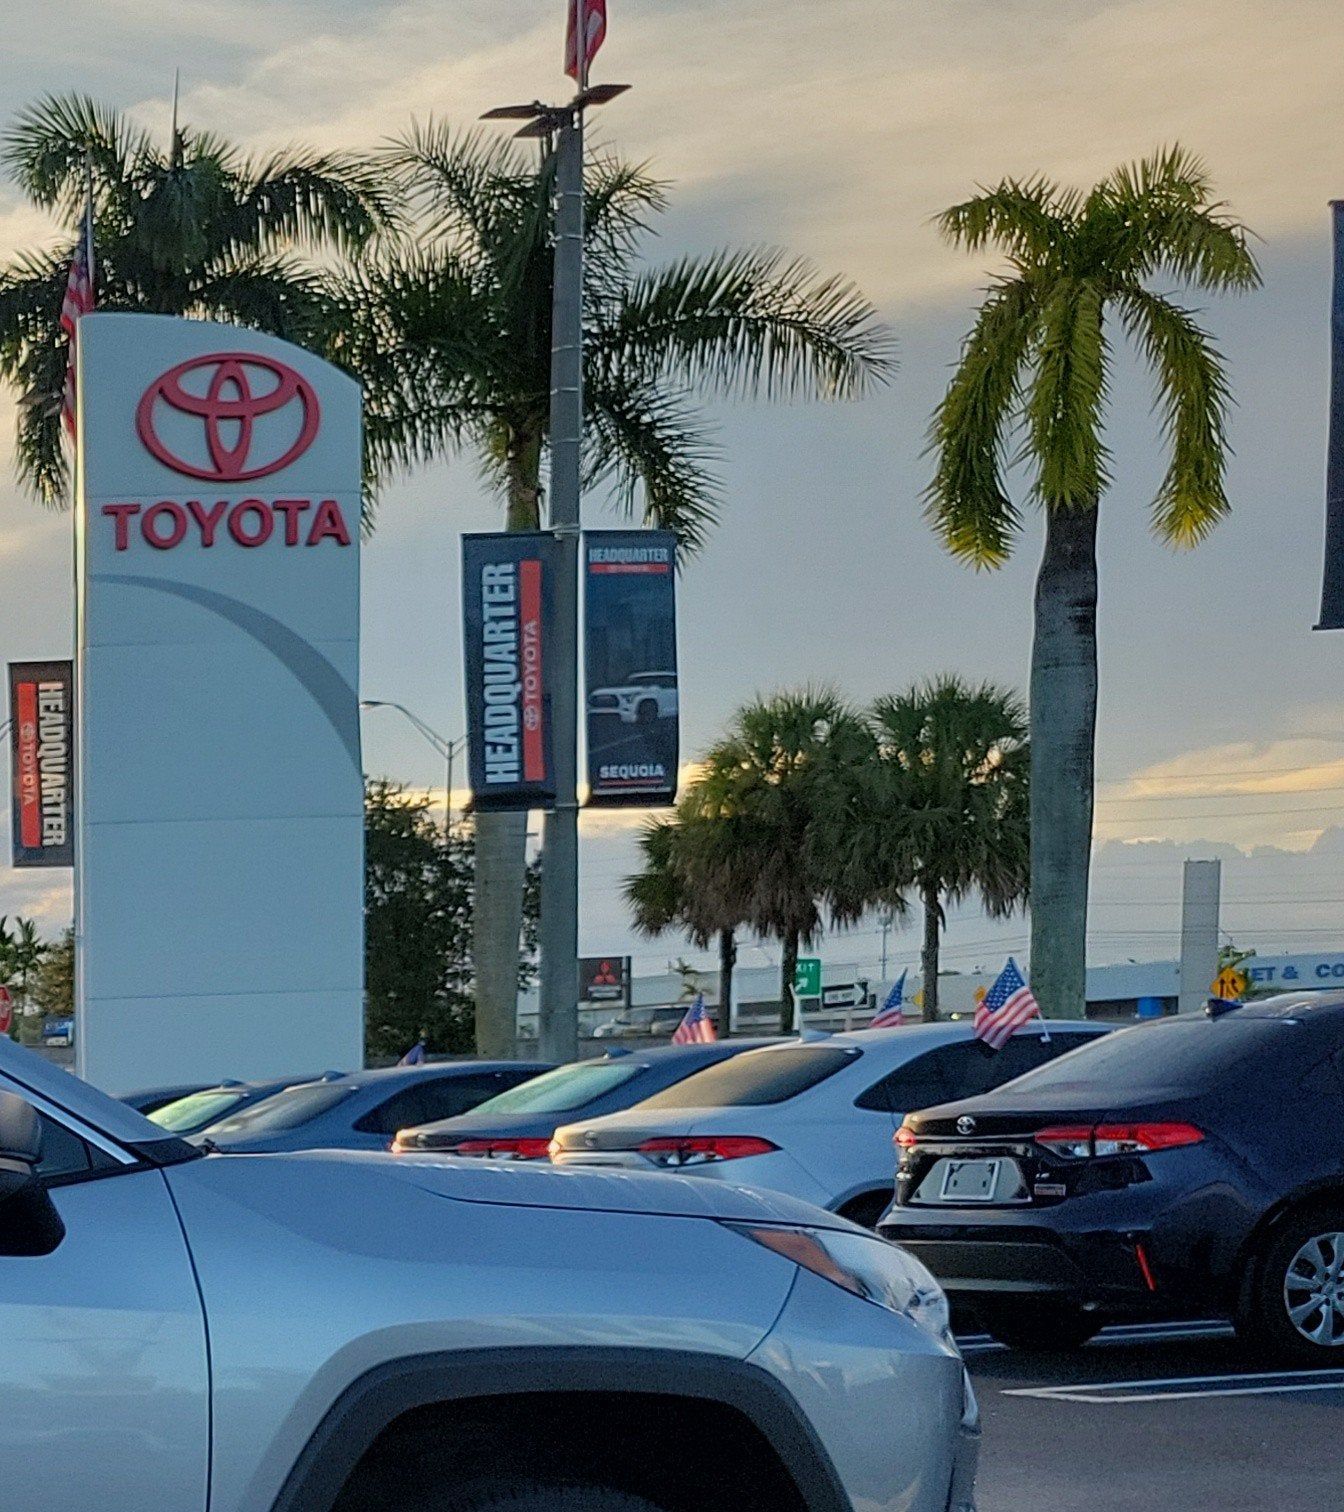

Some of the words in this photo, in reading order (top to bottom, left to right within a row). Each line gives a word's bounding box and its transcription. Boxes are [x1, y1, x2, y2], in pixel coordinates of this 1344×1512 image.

[102, 499, 351, 550] TOYOTA
[589, 548, 669, 563] HEADQUARTER
[482, 563, 522, 784] HEADQUARTER
[524, 621, 539, 698] TOYOTA
[22, 742, 38, 805] TOYOTA
[37, 681, 67, 846] HEADQUARTER
[600, 764, 665, 780] SEQUOIA
[795, 963, 814, 974] XIT
[1281, 966, 1298, 979] &
